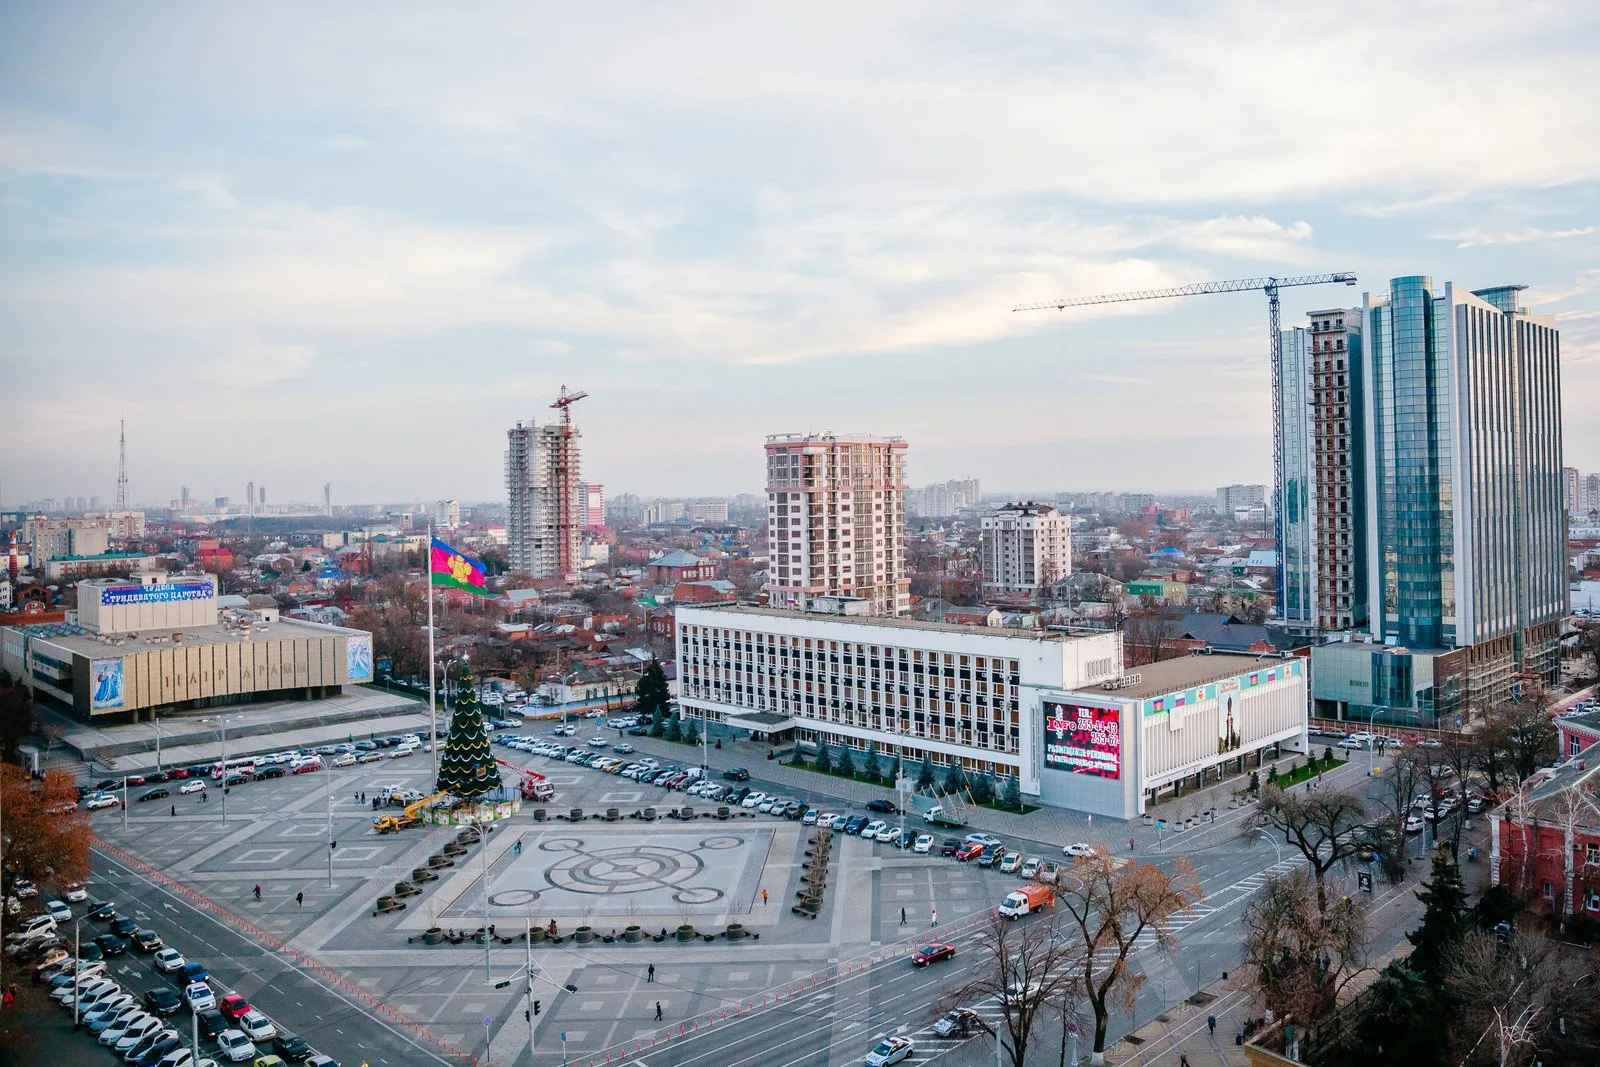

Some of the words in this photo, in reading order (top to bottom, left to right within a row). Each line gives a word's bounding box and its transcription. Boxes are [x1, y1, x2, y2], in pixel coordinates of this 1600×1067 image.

[143, 584, 175, 592] ЧУДЕСА
[110, 592, 169, 603] ТРИДЕВЯТОГО
[171, 590, 207, 600] ЦАРСТВА
[165, 669, 224, 688] ТЕАТР
